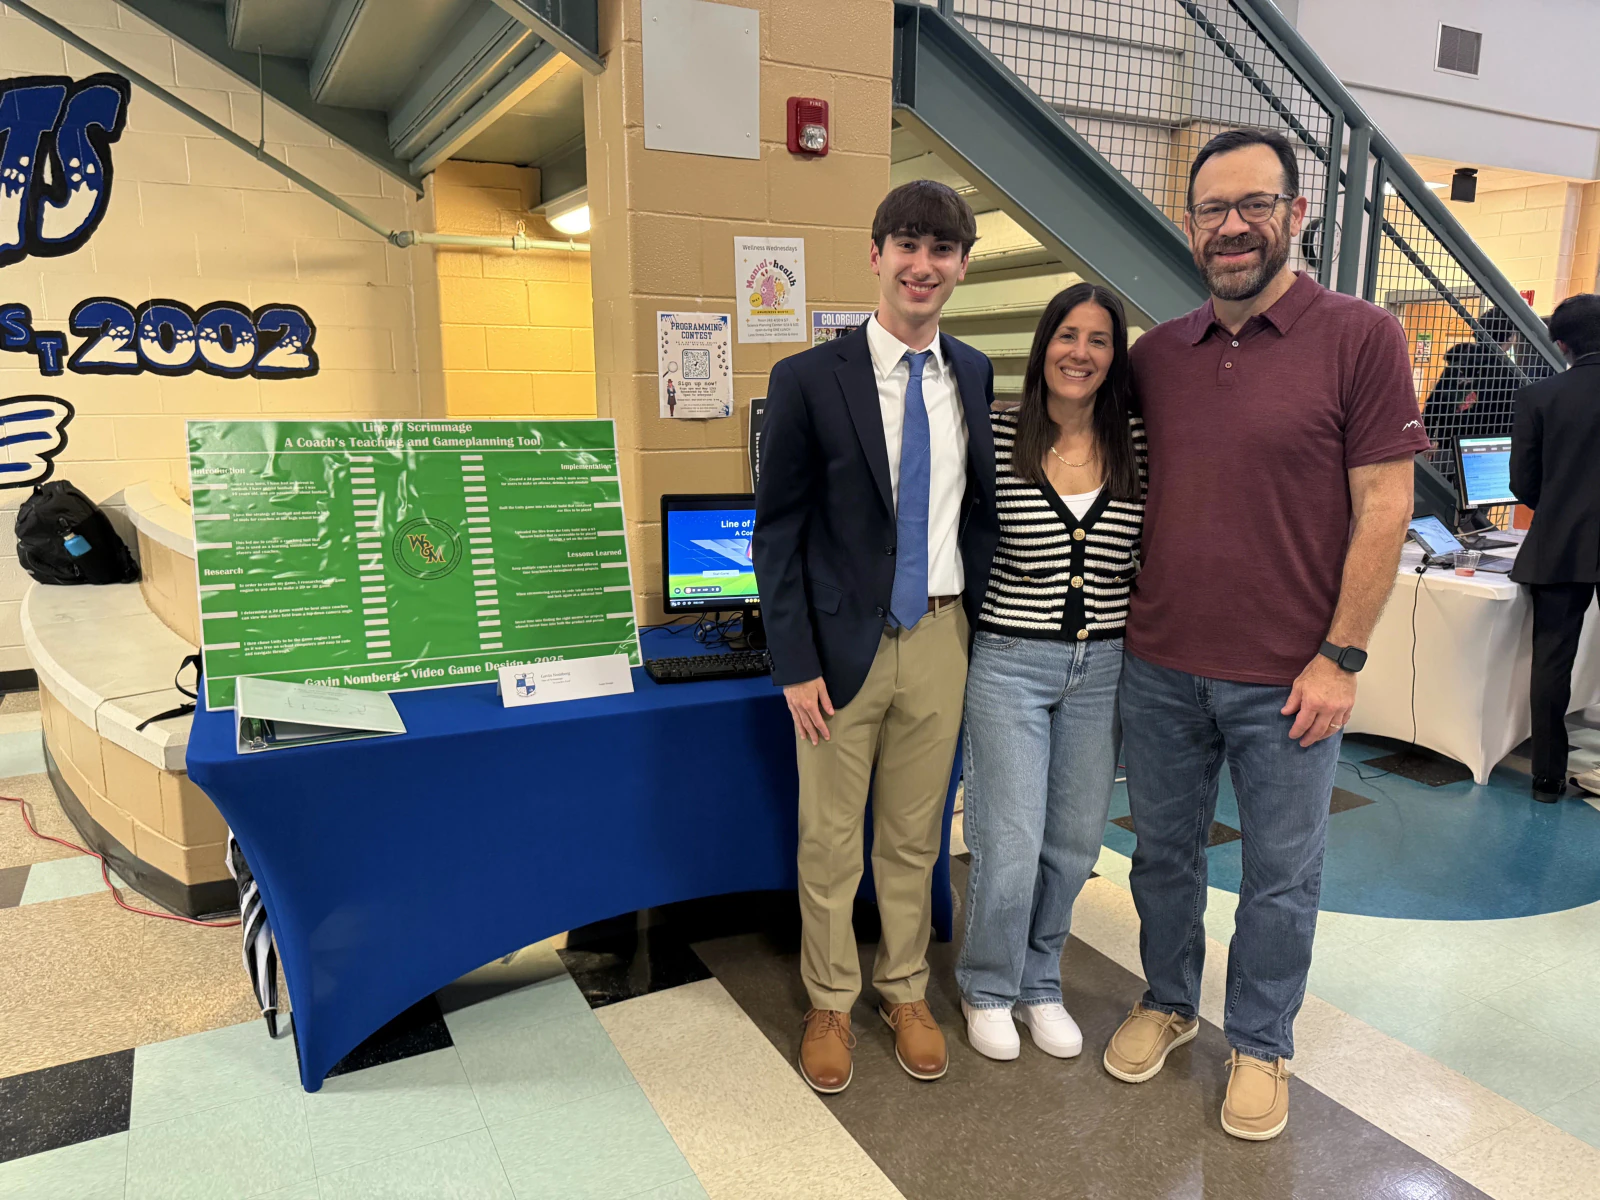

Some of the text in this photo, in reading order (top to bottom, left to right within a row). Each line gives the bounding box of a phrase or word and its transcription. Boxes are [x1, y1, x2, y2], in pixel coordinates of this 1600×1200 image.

[773, 259, 797, 287] health
[822, 314, 870, 326] COLORGUAR
[671, 322, 722, 331] PROGRAMMING
[68, 297, 319, 379] 2002
[682, 331, 713, 340] CONTEST
[362, 422, 472, 434] Line of Scrimmage
[285, 436, 541, 448] A Coach's Teaching and Gameplanning Tool
[204, 567, 244, 576] Research
[304, 677, 340, 687] Gavin
[344, 671, 401, 685] Nomberg
[411, 668, 444, 679] Video
[448, 664, 481, 676] Game
[485, 660, 523, 672] Design
